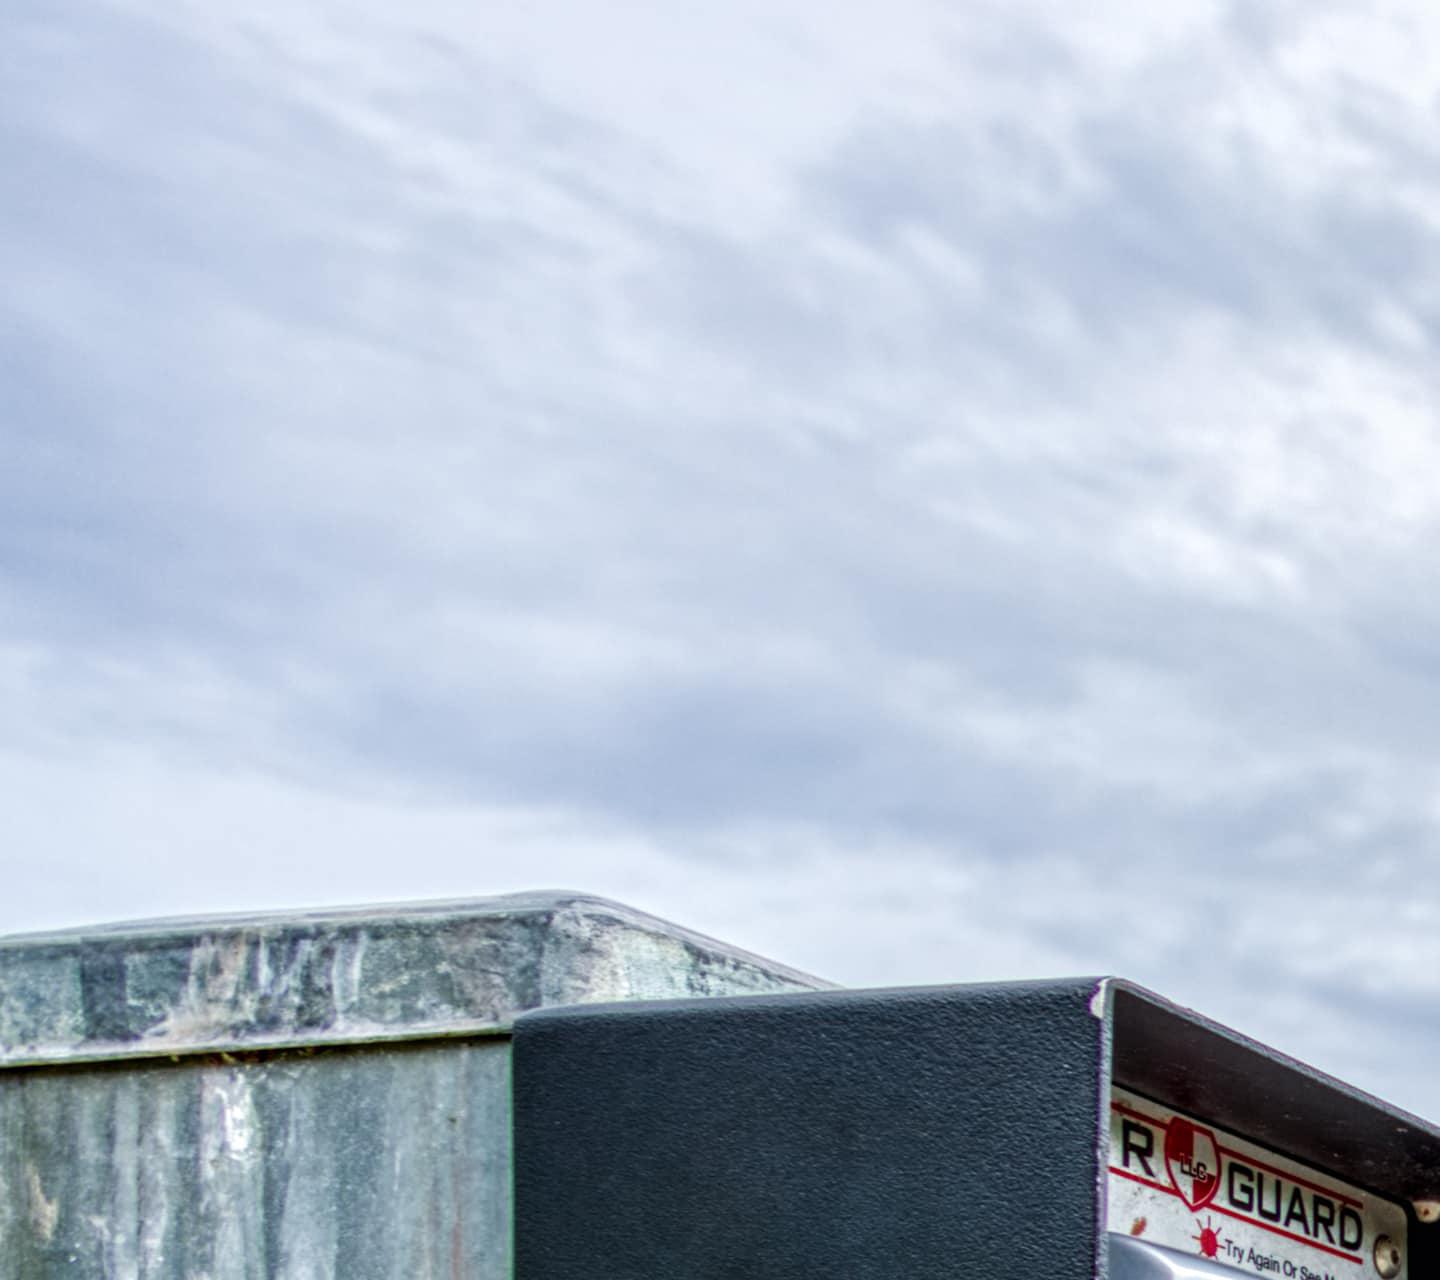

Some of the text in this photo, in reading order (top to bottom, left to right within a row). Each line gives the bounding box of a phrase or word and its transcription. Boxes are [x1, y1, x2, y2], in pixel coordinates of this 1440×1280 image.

[1179, 1152, 1208, 1183] LLC
[1227, 1160, 1364, 1252] GUARD
[1224, 1238, 1245, 1264] Try
[1247, 1247, 1281, 1274] Again
[1282, 1259, 1298, 1279] Or
